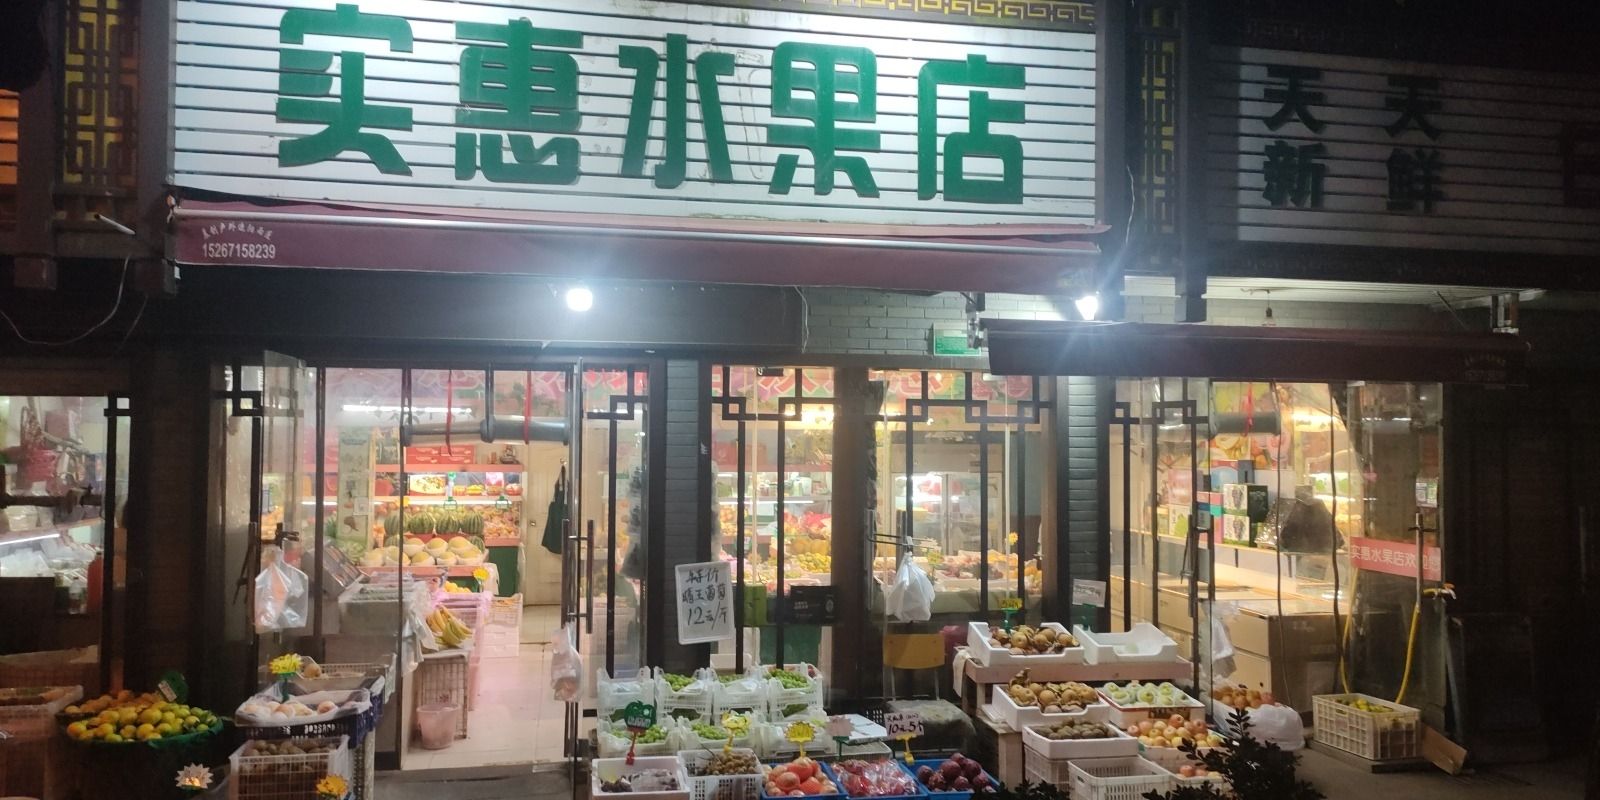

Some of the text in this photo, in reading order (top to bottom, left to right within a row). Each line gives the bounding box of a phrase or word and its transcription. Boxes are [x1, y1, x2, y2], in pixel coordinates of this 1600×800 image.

[275, 3, 1026, 205] 实惠水果店
[202, 242, 276, 259] 15267158239
[685, 567, 719, 585] 特价
